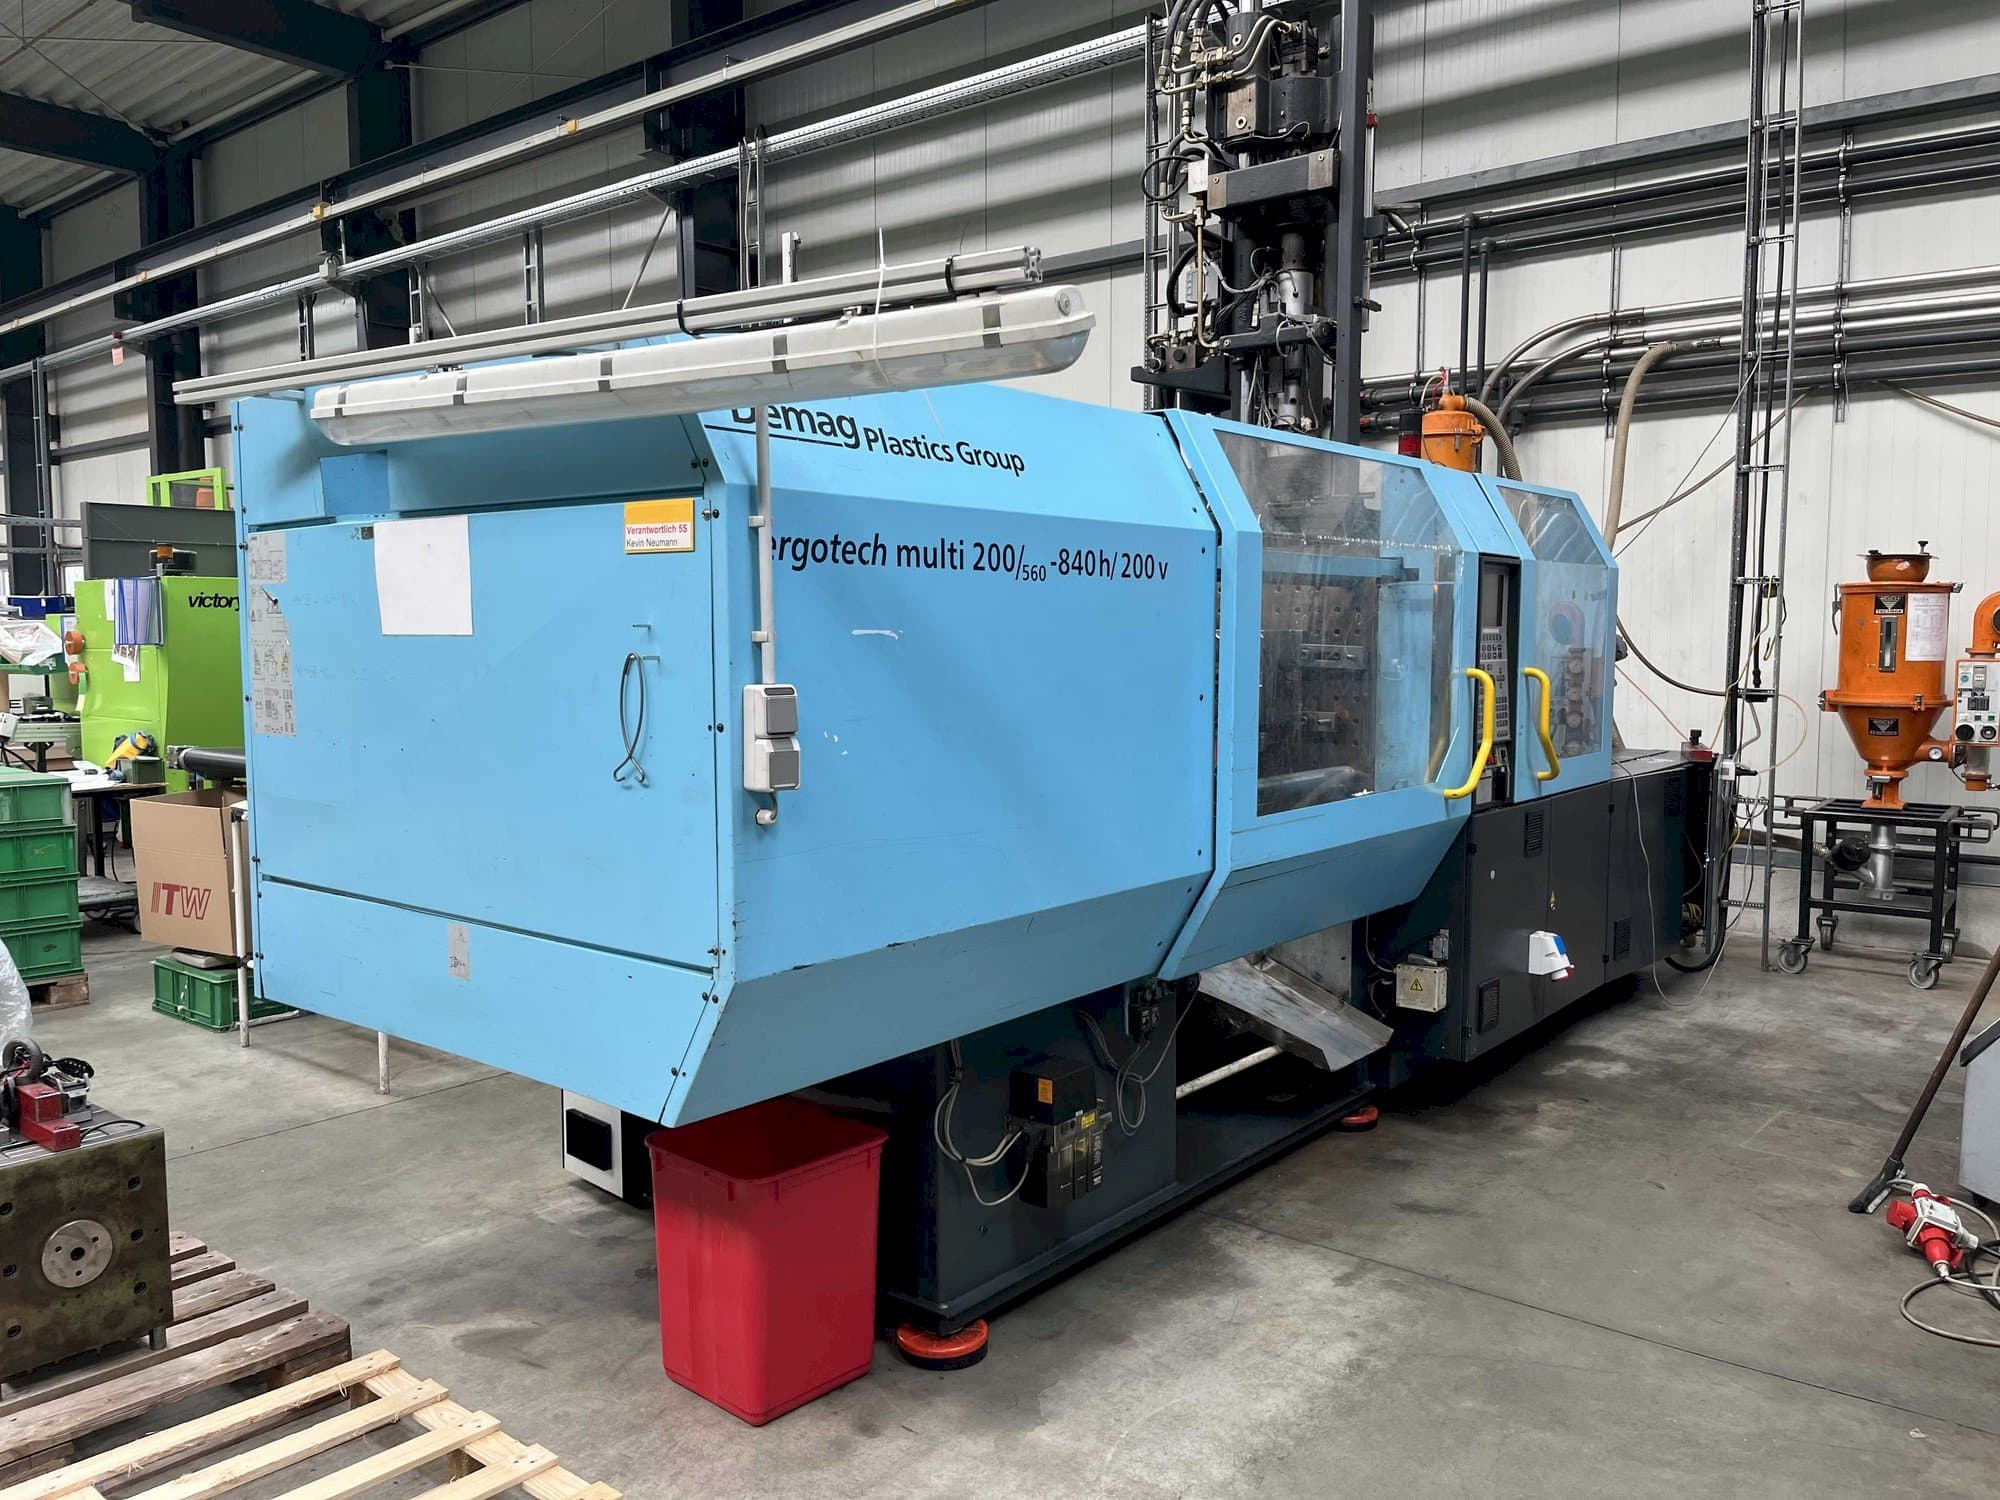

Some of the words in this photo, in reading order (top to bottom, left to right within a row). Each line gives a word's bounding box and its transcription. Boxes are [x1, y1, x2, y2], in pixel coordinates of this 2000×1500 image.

[863, 427, 954, 462] Plastics
[956, 441, 1025, 476] Group
[626, 525, 676, 534] Verantwortlich
[678, 524, 688, 533] 5S
[627, 538, 644, 547] Kevin
[646, 538, 678, 547] Neumann
[771, 532, 887, 571] rgotech
[896, 538, 964, 570] multi
[150, 882, 212, 920] ITW
